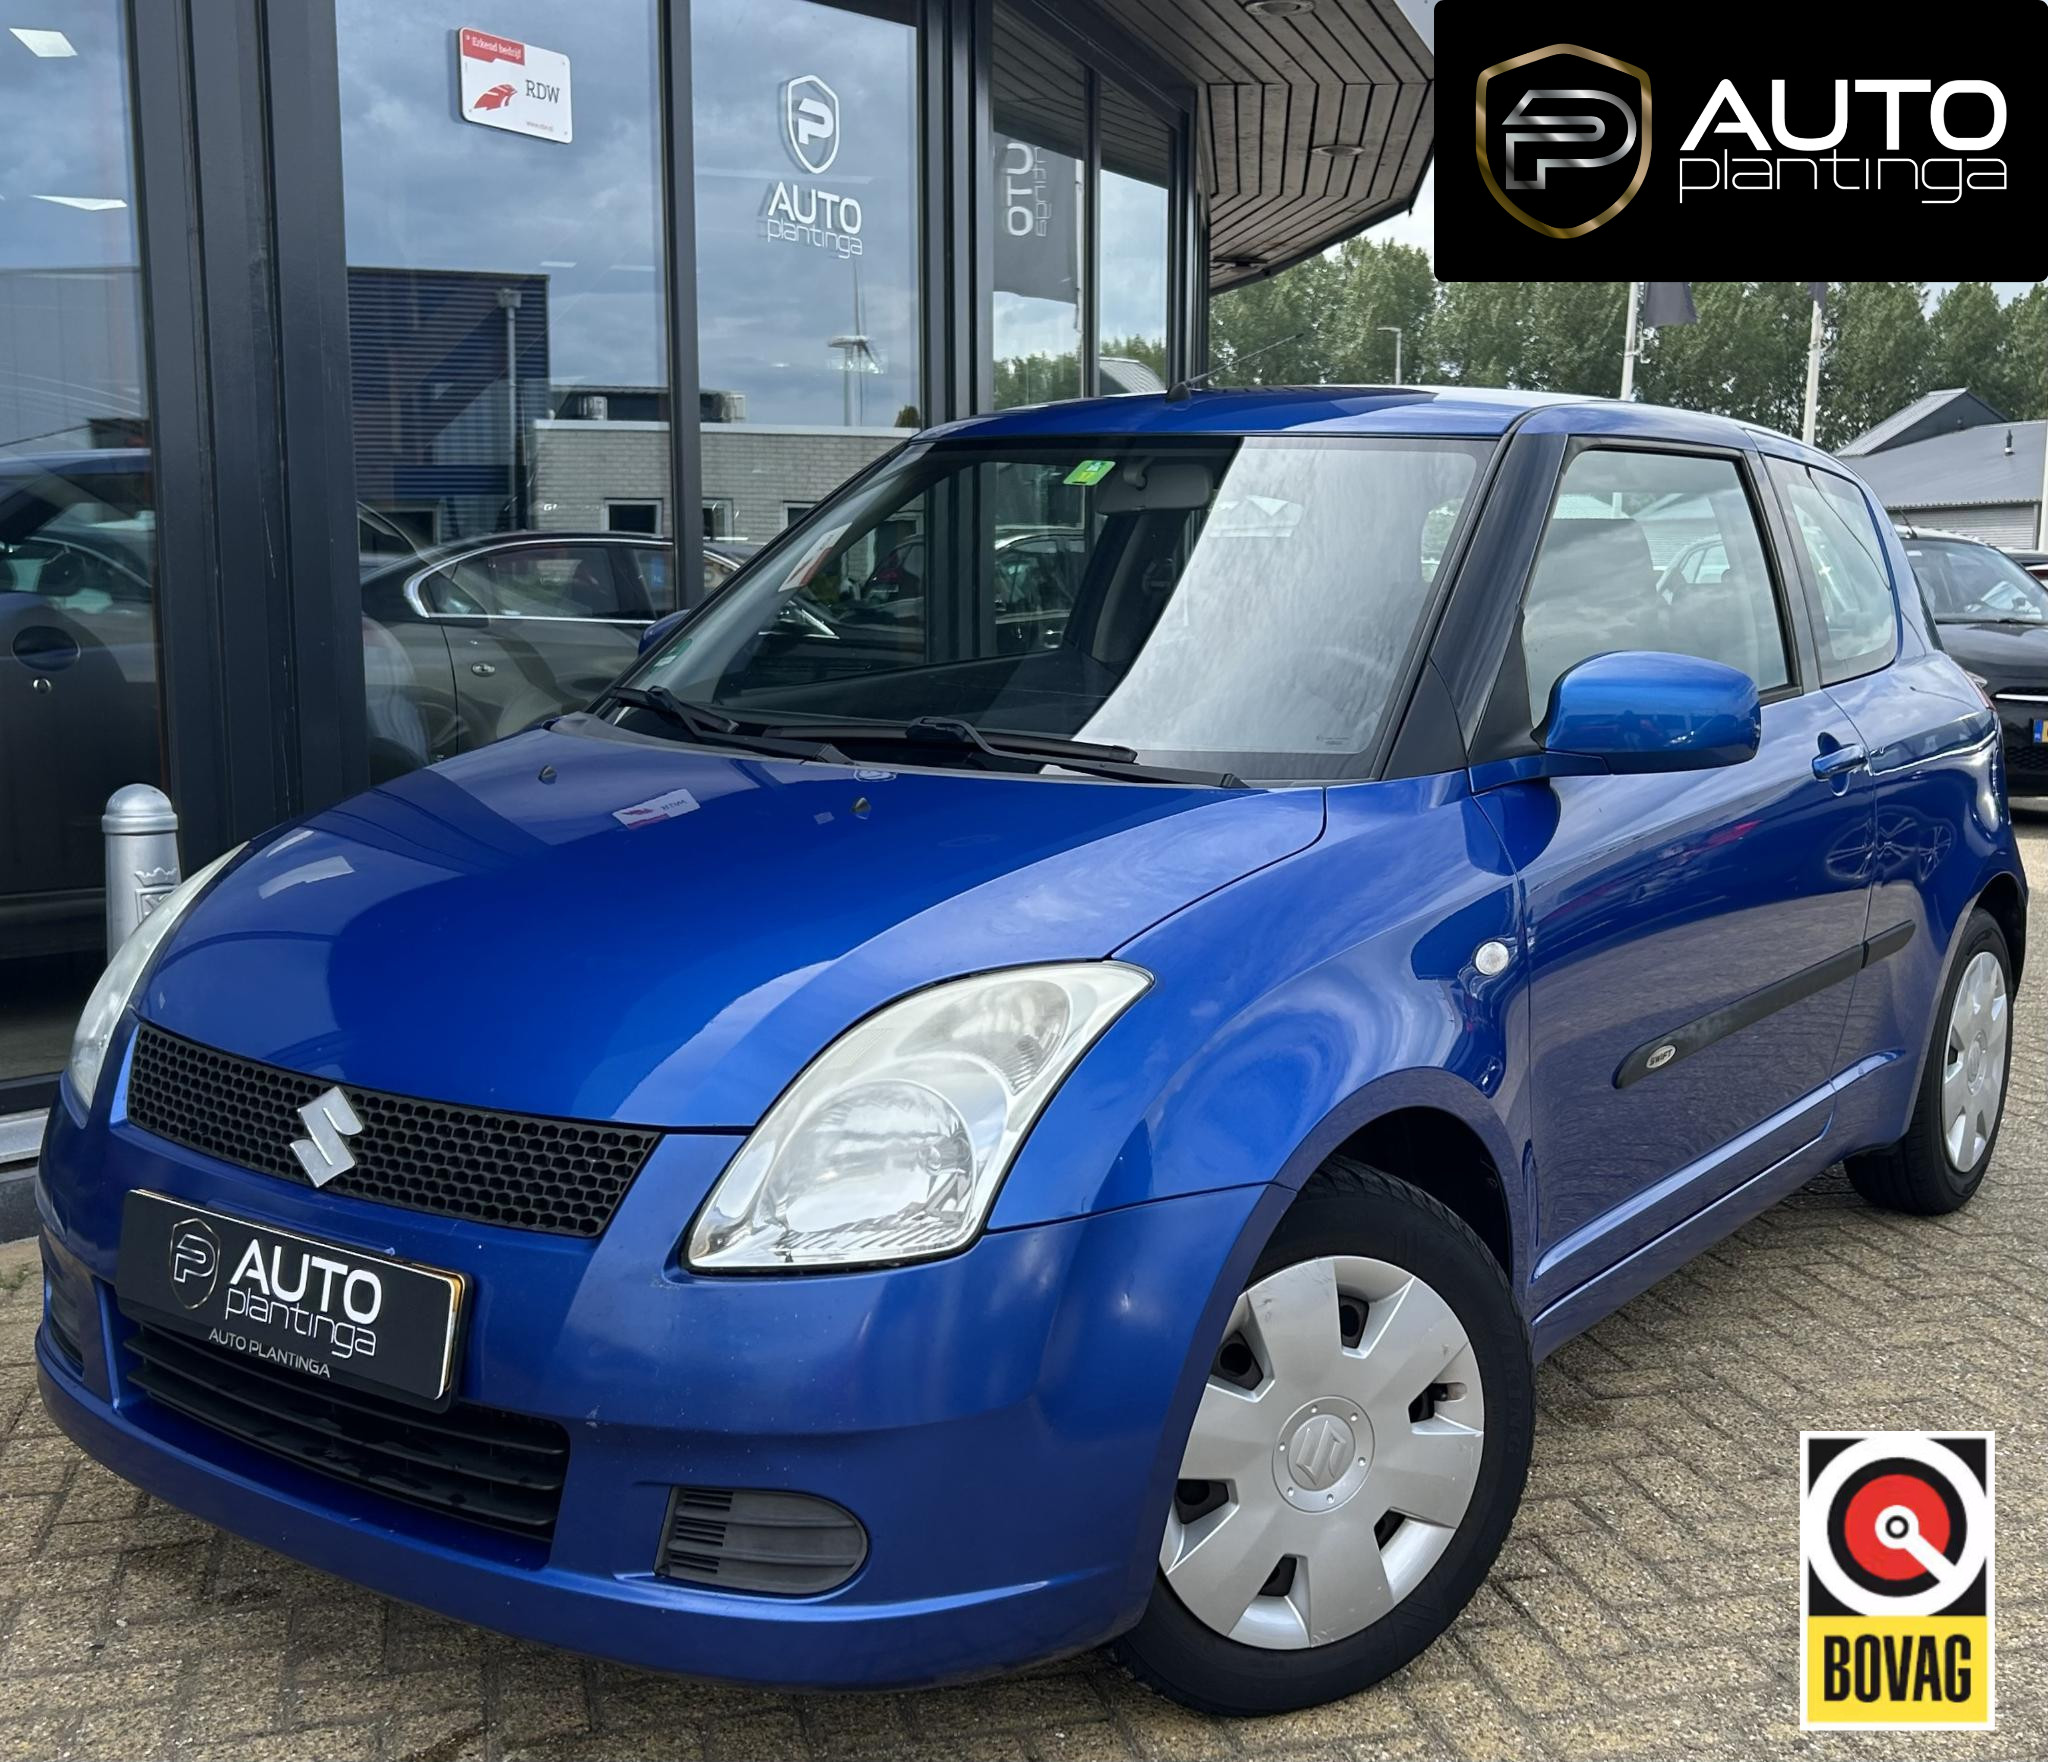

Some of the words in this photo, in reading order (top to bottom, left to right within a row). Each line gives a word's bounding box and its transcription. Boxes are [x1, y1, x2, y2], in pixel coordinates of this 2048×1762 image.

[525, 79, 560, 104] RDW
[767, 181, 862, 235] AUTO
[767, 217, 863, 260] plantinga
[230, 1238, 383, 1326] AUTO
[225, 1287, 377, 1360] plantinga
[208, 1327, 247, 1351] AUTO
[249, 1340, 331, 1379] PLANTINGA
